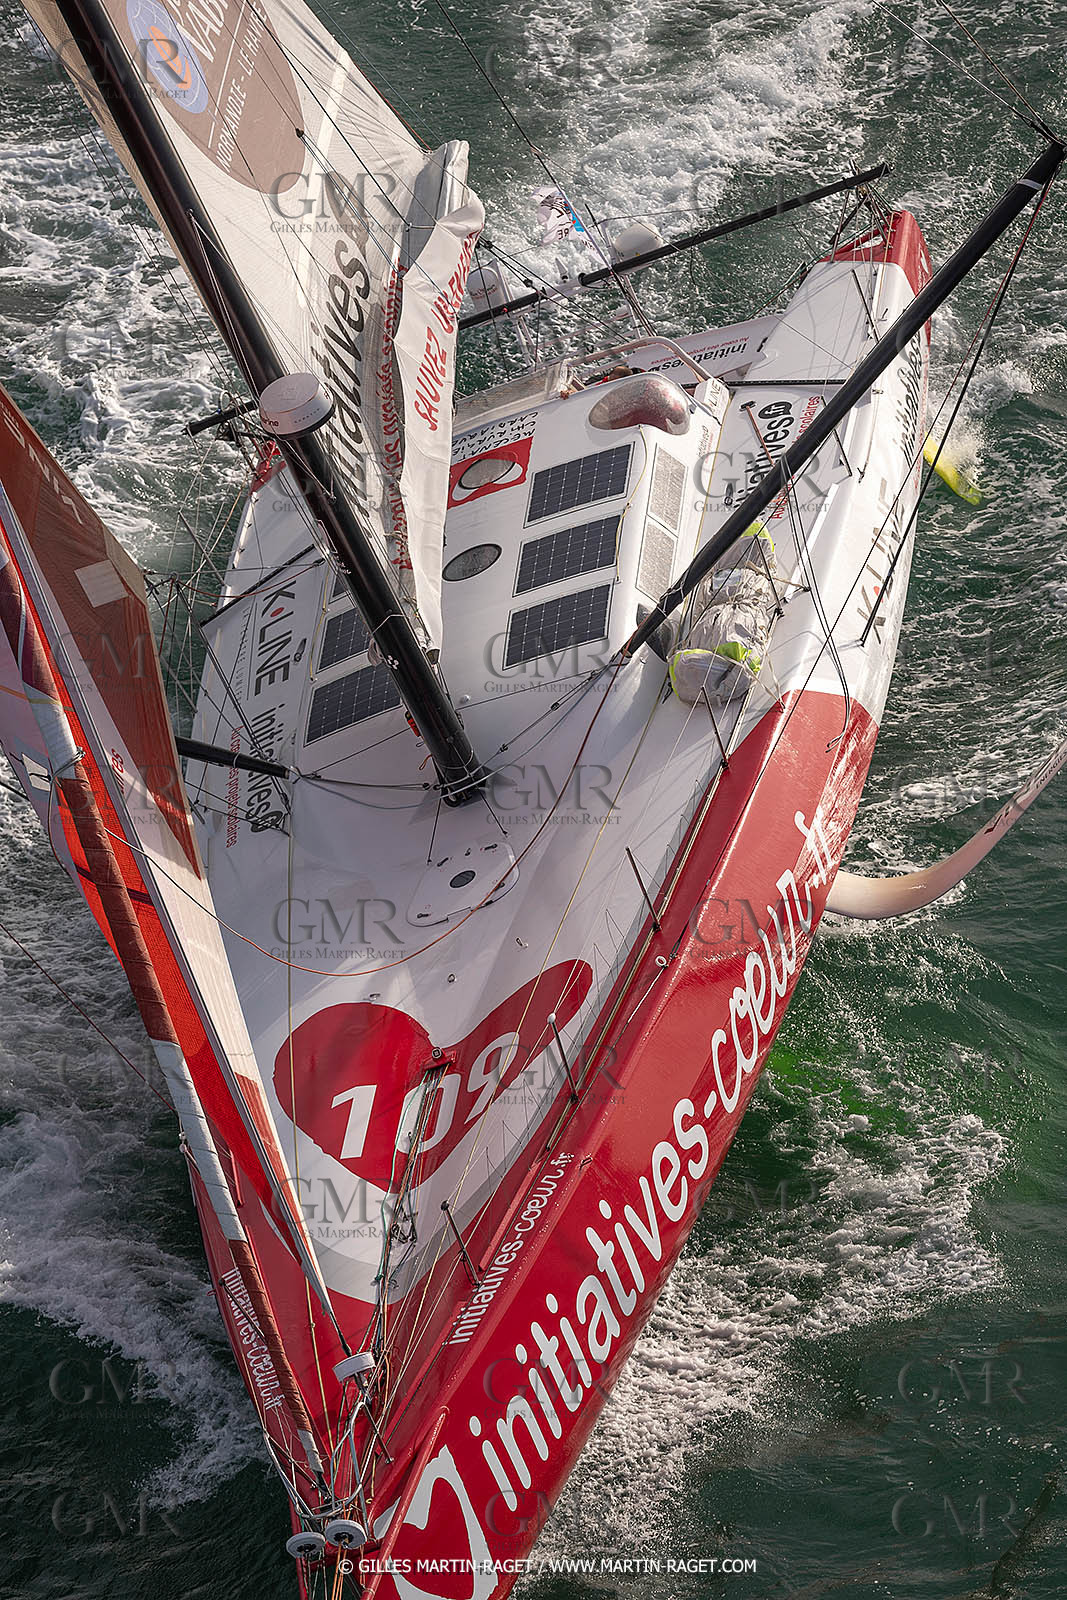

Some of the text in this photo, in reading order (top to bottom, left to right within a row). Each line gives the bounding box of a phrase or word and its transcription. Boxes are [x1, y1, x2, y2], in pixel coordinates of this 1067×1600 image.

[215, 79, 247, 173] NORMANDIE
[237, 48, 255, 76] LE
[414, 326, 447, 432] SAUVEZ
[330, 1031, 521, 1160] 109
